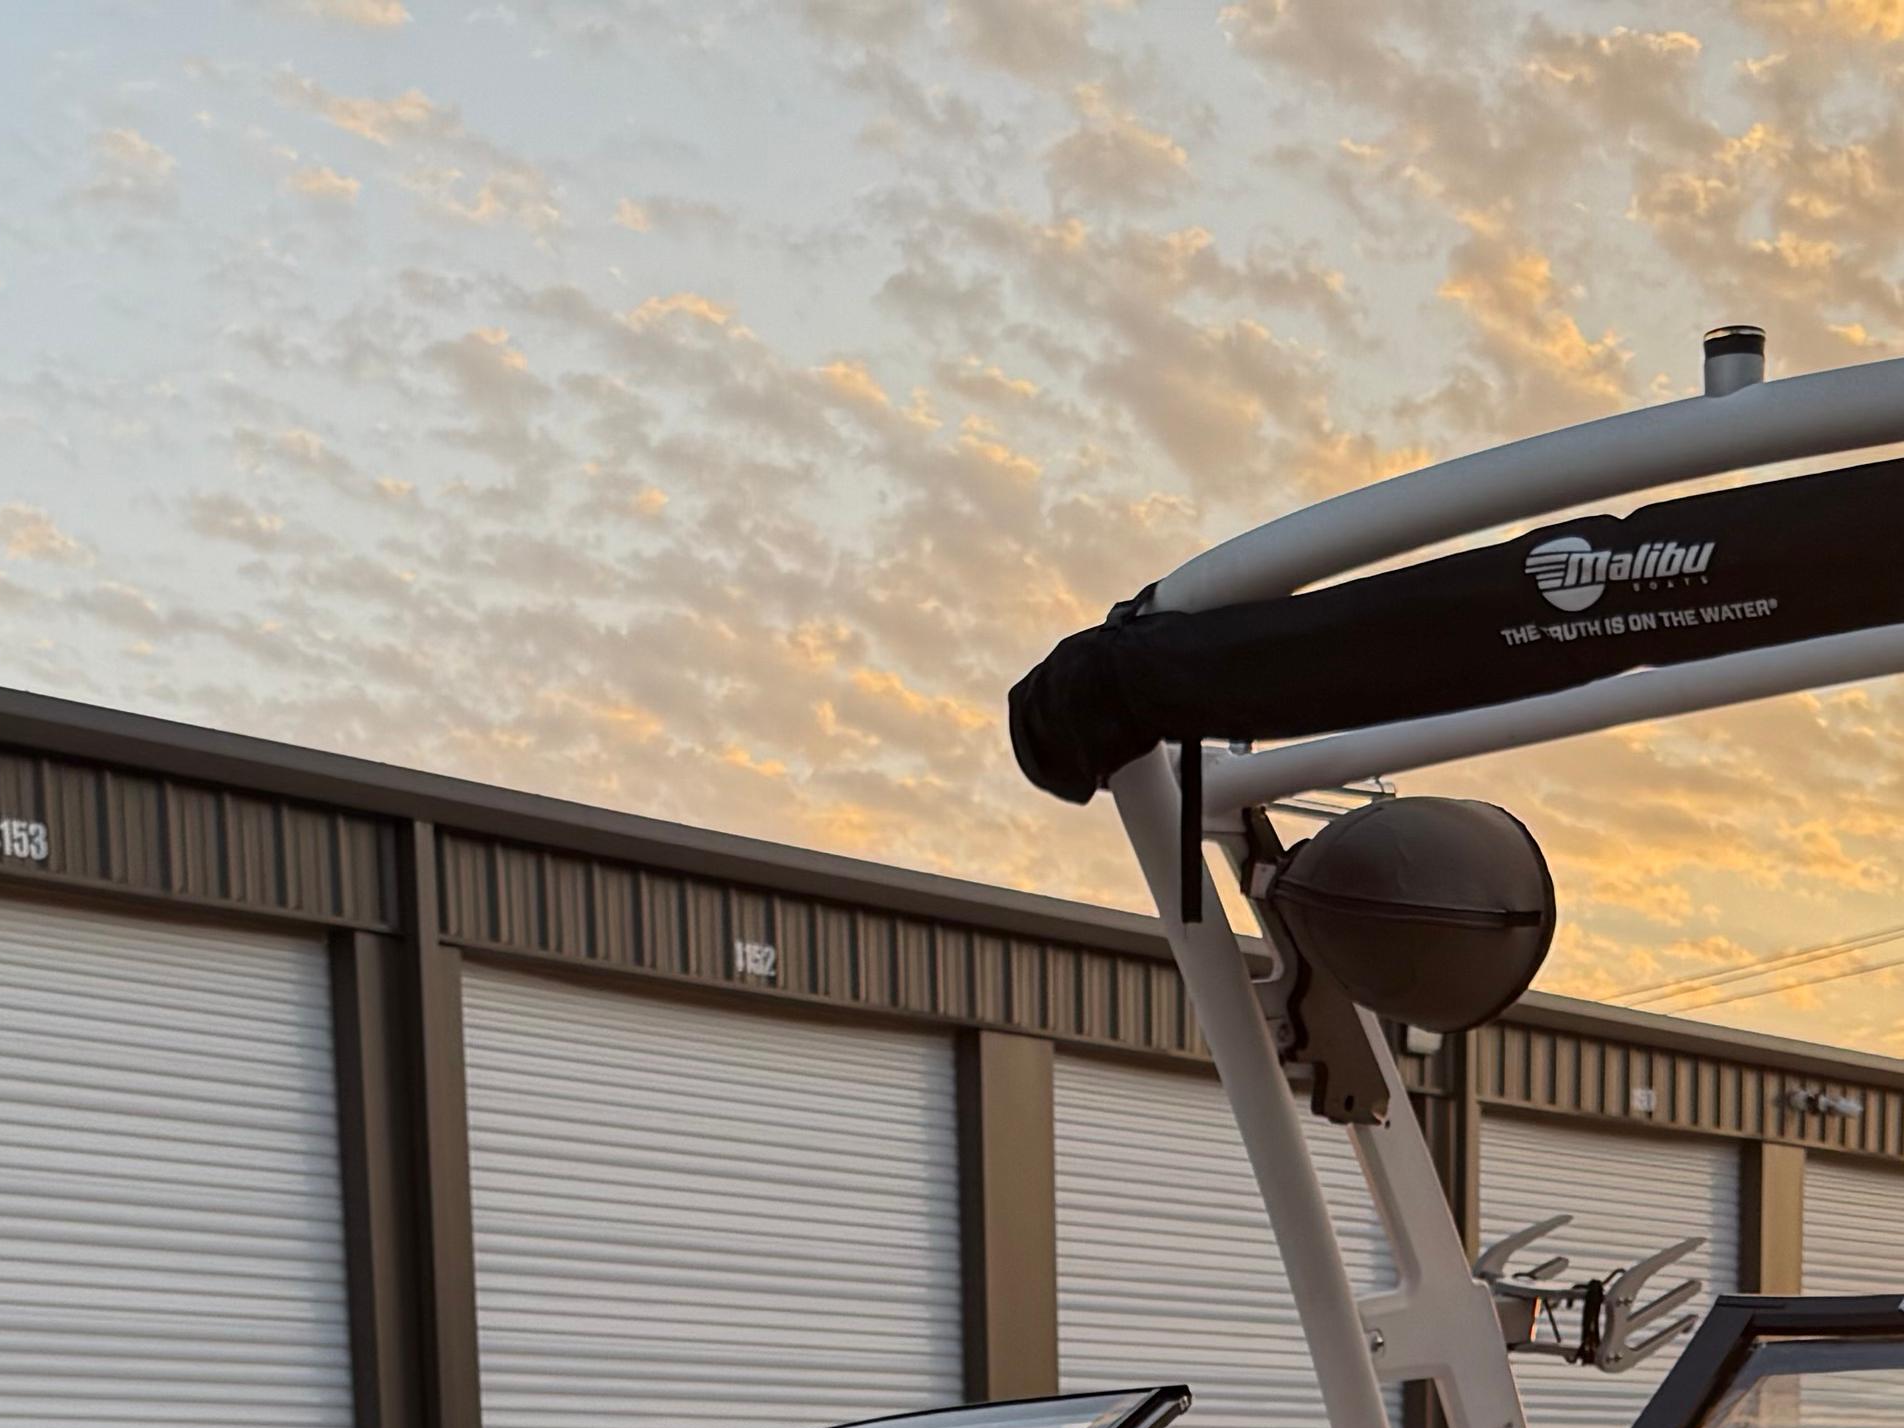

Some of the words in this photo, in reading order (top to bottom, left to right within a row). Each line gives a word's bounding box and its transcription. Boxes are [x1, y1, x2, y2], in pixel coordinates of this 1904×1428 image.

[1500, 624, 1542, 646] THE
[1604, 615, 1625, 636] IS
[1629, 612, 1657, 633] ON
[1658, 609, 1699, 629] THE
